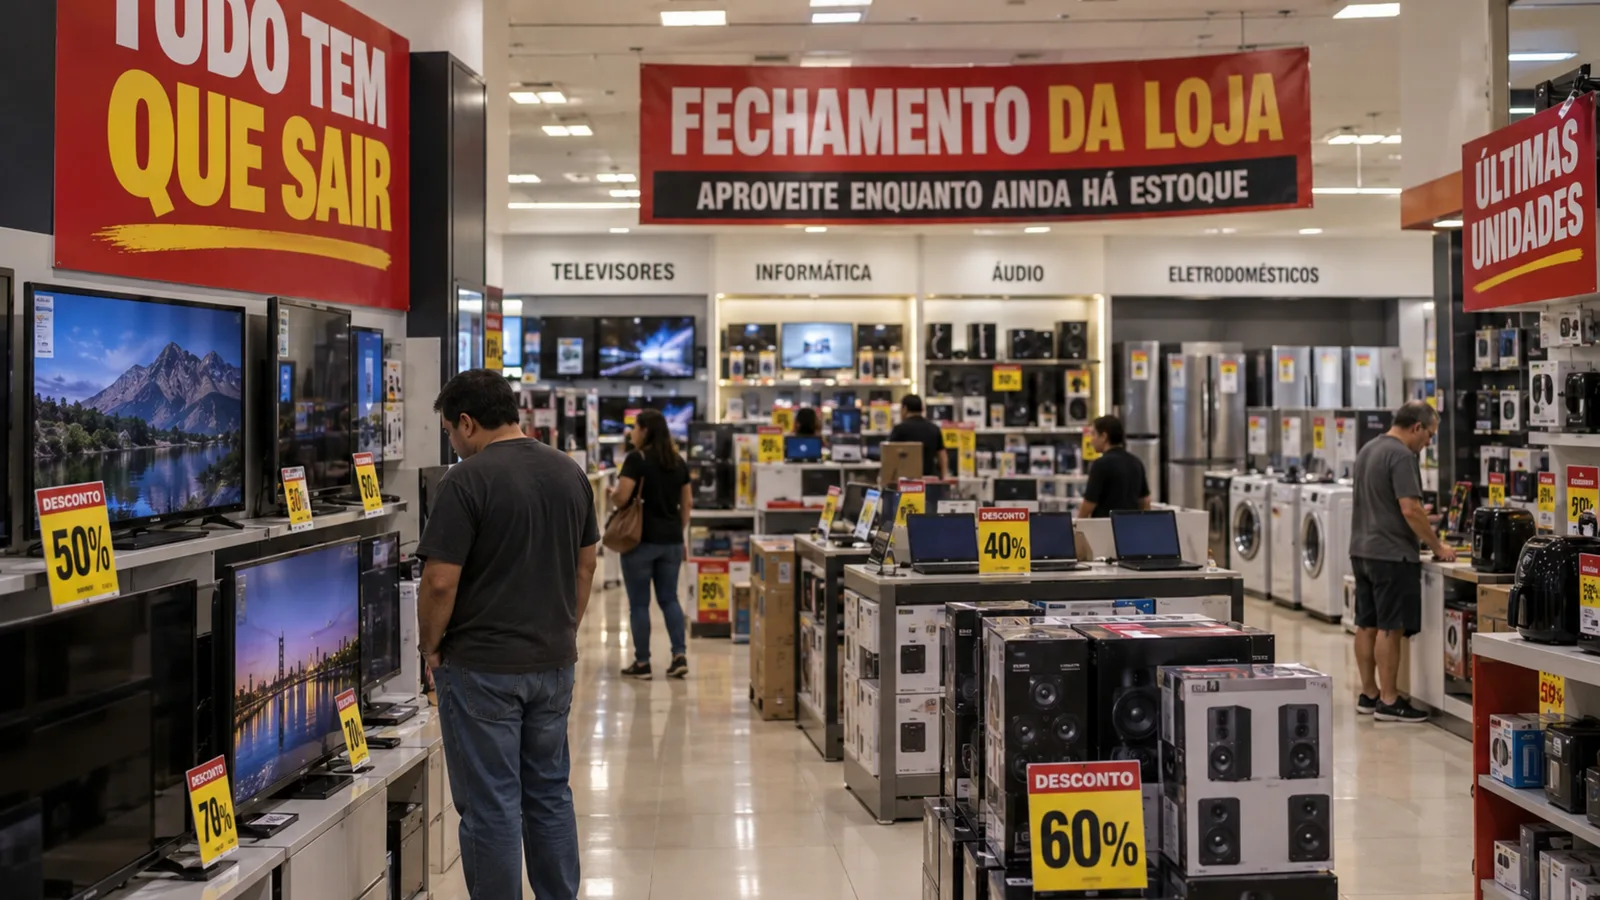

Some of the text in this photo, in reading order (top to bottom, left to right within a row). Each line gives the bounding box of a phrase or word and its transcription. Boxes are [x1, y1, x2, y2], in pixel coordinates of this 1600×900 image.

[301, 12, 387, 129] TEM
[671, 73, 1284, 156] FECHAMENTO DA LOJA
[107, 69, 392, 232] QUE SAIR
[1475, 118, 1579, 210] ÚLTIMAS
[697, 169, 1249, 213] APROVEITE ENQUANTO AINDA HÁ ESTOQUE
[1471, 182, 1584, 270] UNIDADES
[551, 262, 675, 281] TELEVISORES
[756, 260, 872, 282] INFORMÁTICA
[992, 261, 1045, 282] ÁUDIO
[1168, 262, 1320, 283] ELETRODOMÉSTICOS
[42, 490, 101, 511] DESCONTO
[981, 512, 1026, 520] DESCONTO
[52, 525, 110, 581] 50%
[984, 531, 1027, 560] 40%
[191, 764, 224, 788] DESCONTO
[1035, 771, 1134, 789] DESCONTO
[1041, 809, 1139, 869] 60%
